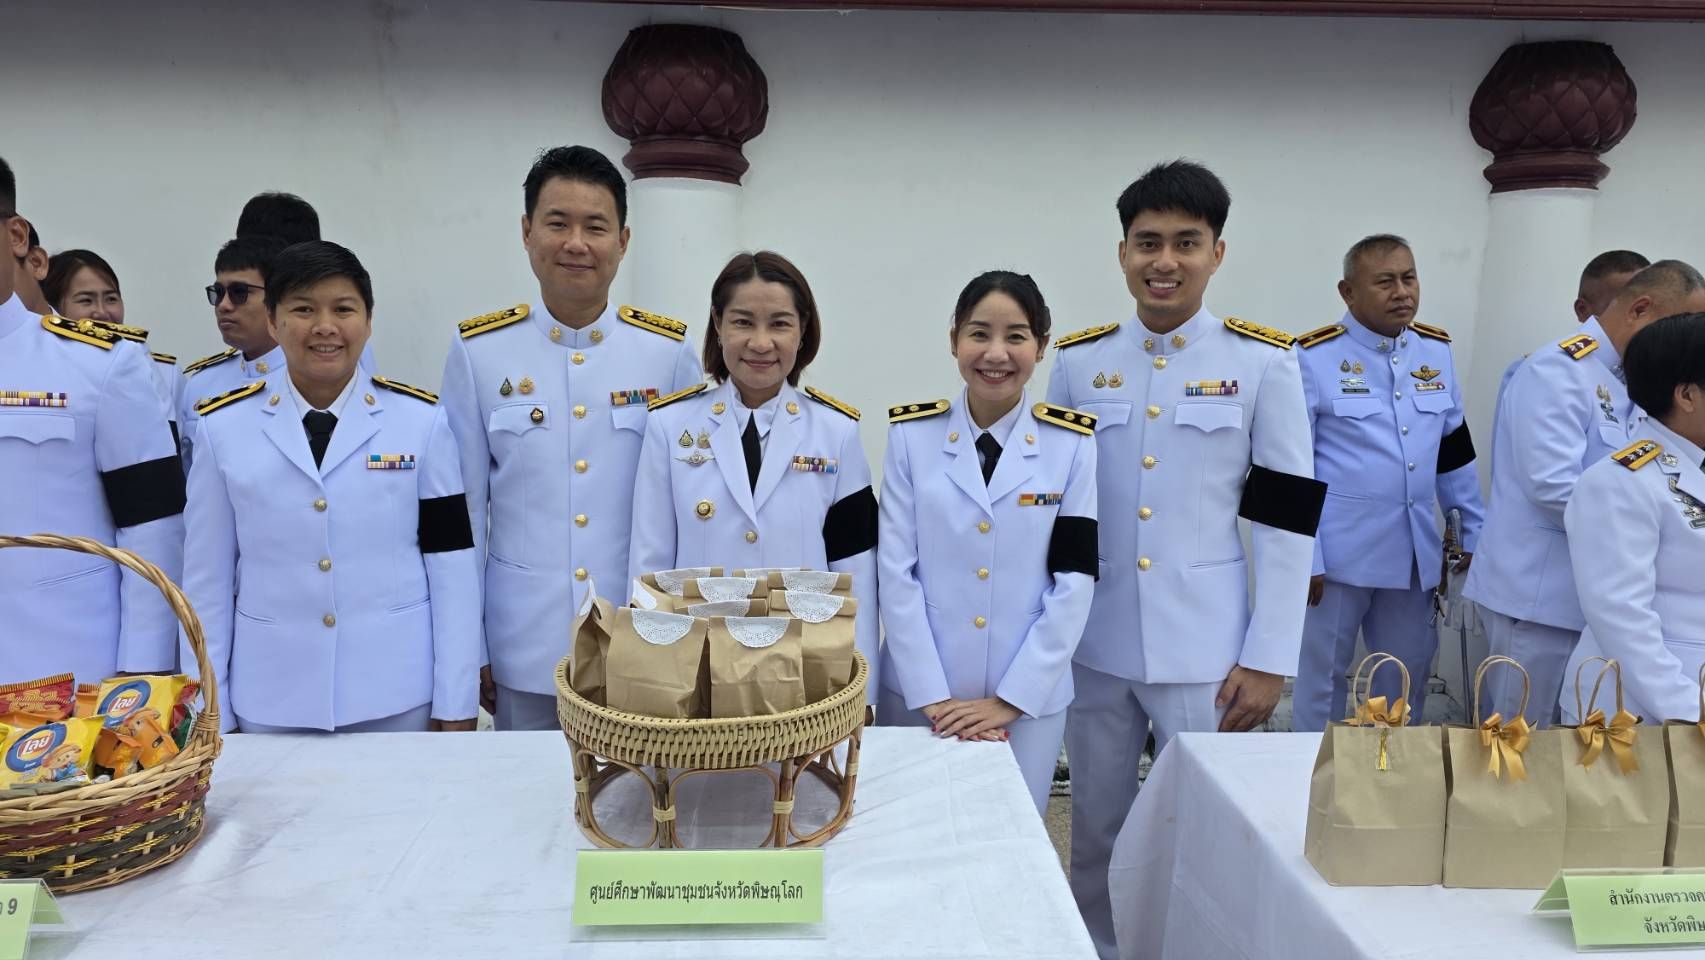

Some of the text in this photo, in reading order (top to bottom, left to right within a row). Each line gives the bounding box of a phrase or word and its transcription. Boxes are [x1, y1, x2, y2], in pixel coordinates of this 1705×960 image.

[590, 880, 803, 904] ศูนย์ศึกษาพัฒนาชุมชนจังหวัดพิษณุโลก
[1609, 888, 1705, 905] สำนักงานตรวจค
[7, 897, 18, 915] 9
